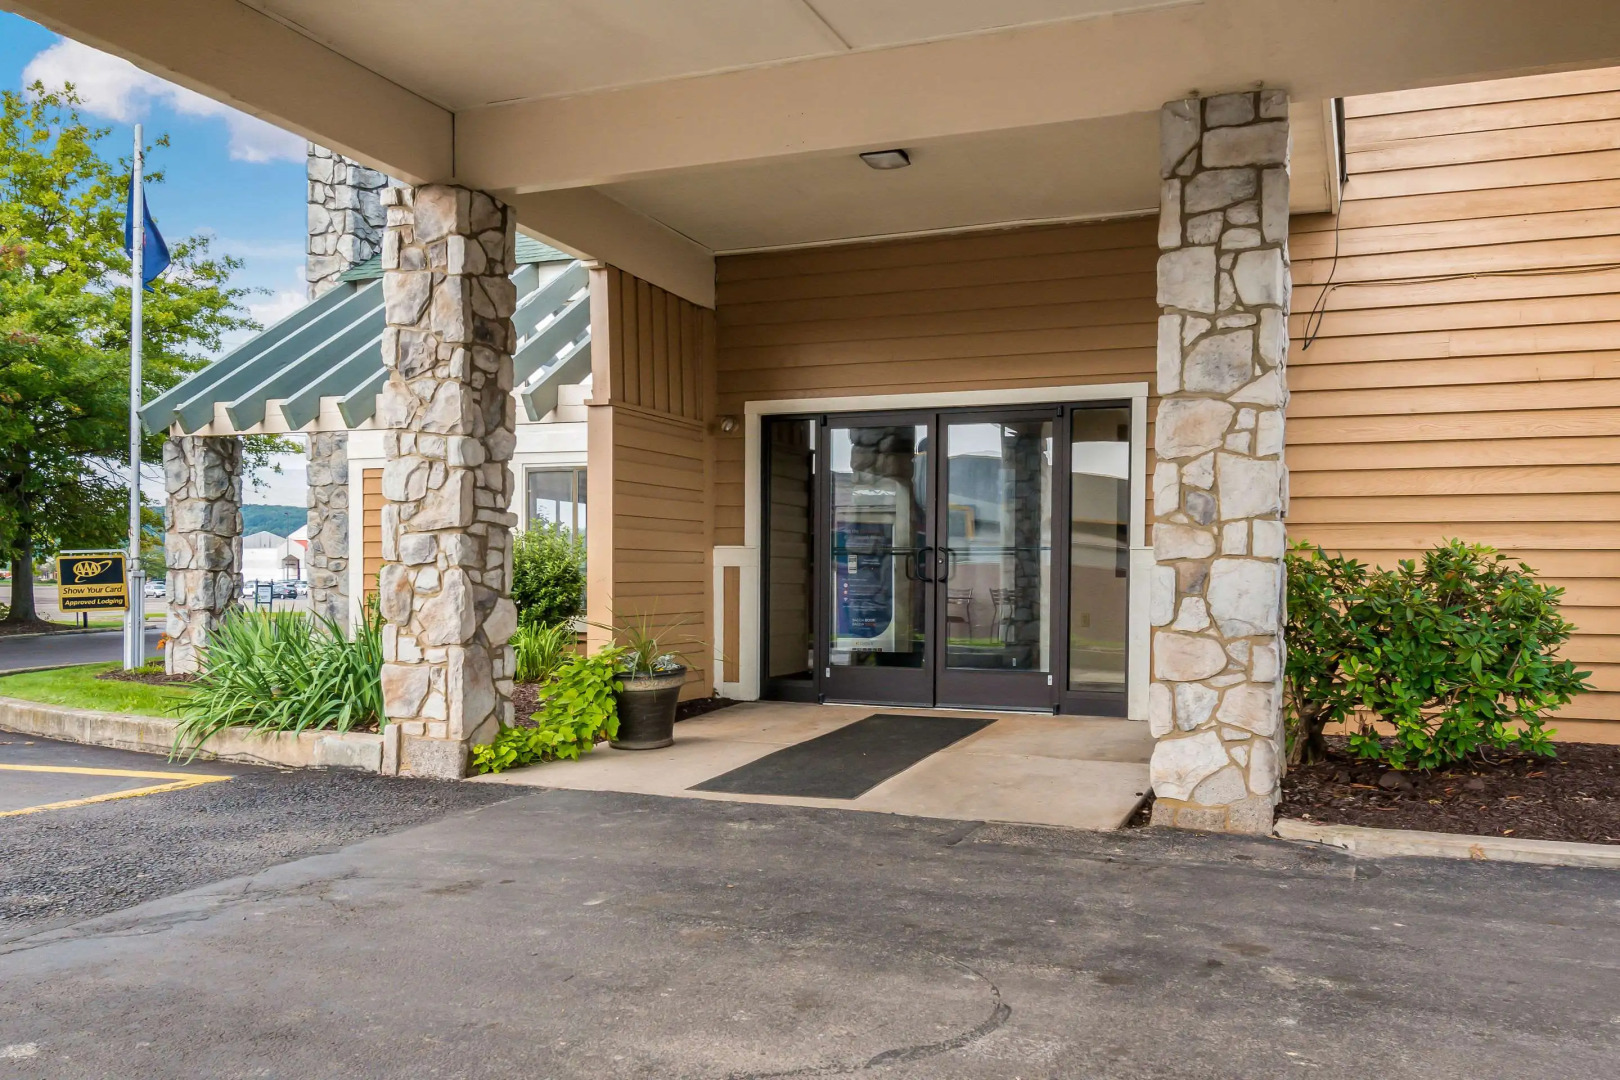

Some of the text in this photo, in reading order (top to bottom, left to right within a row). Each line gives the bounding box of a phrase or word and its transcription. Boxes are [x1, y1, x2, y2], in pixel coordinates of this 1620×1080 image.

[75, 561, 98, 576] AAA
[63, 587, 85, 595] Show
[105, 585, 123, 593] Card
